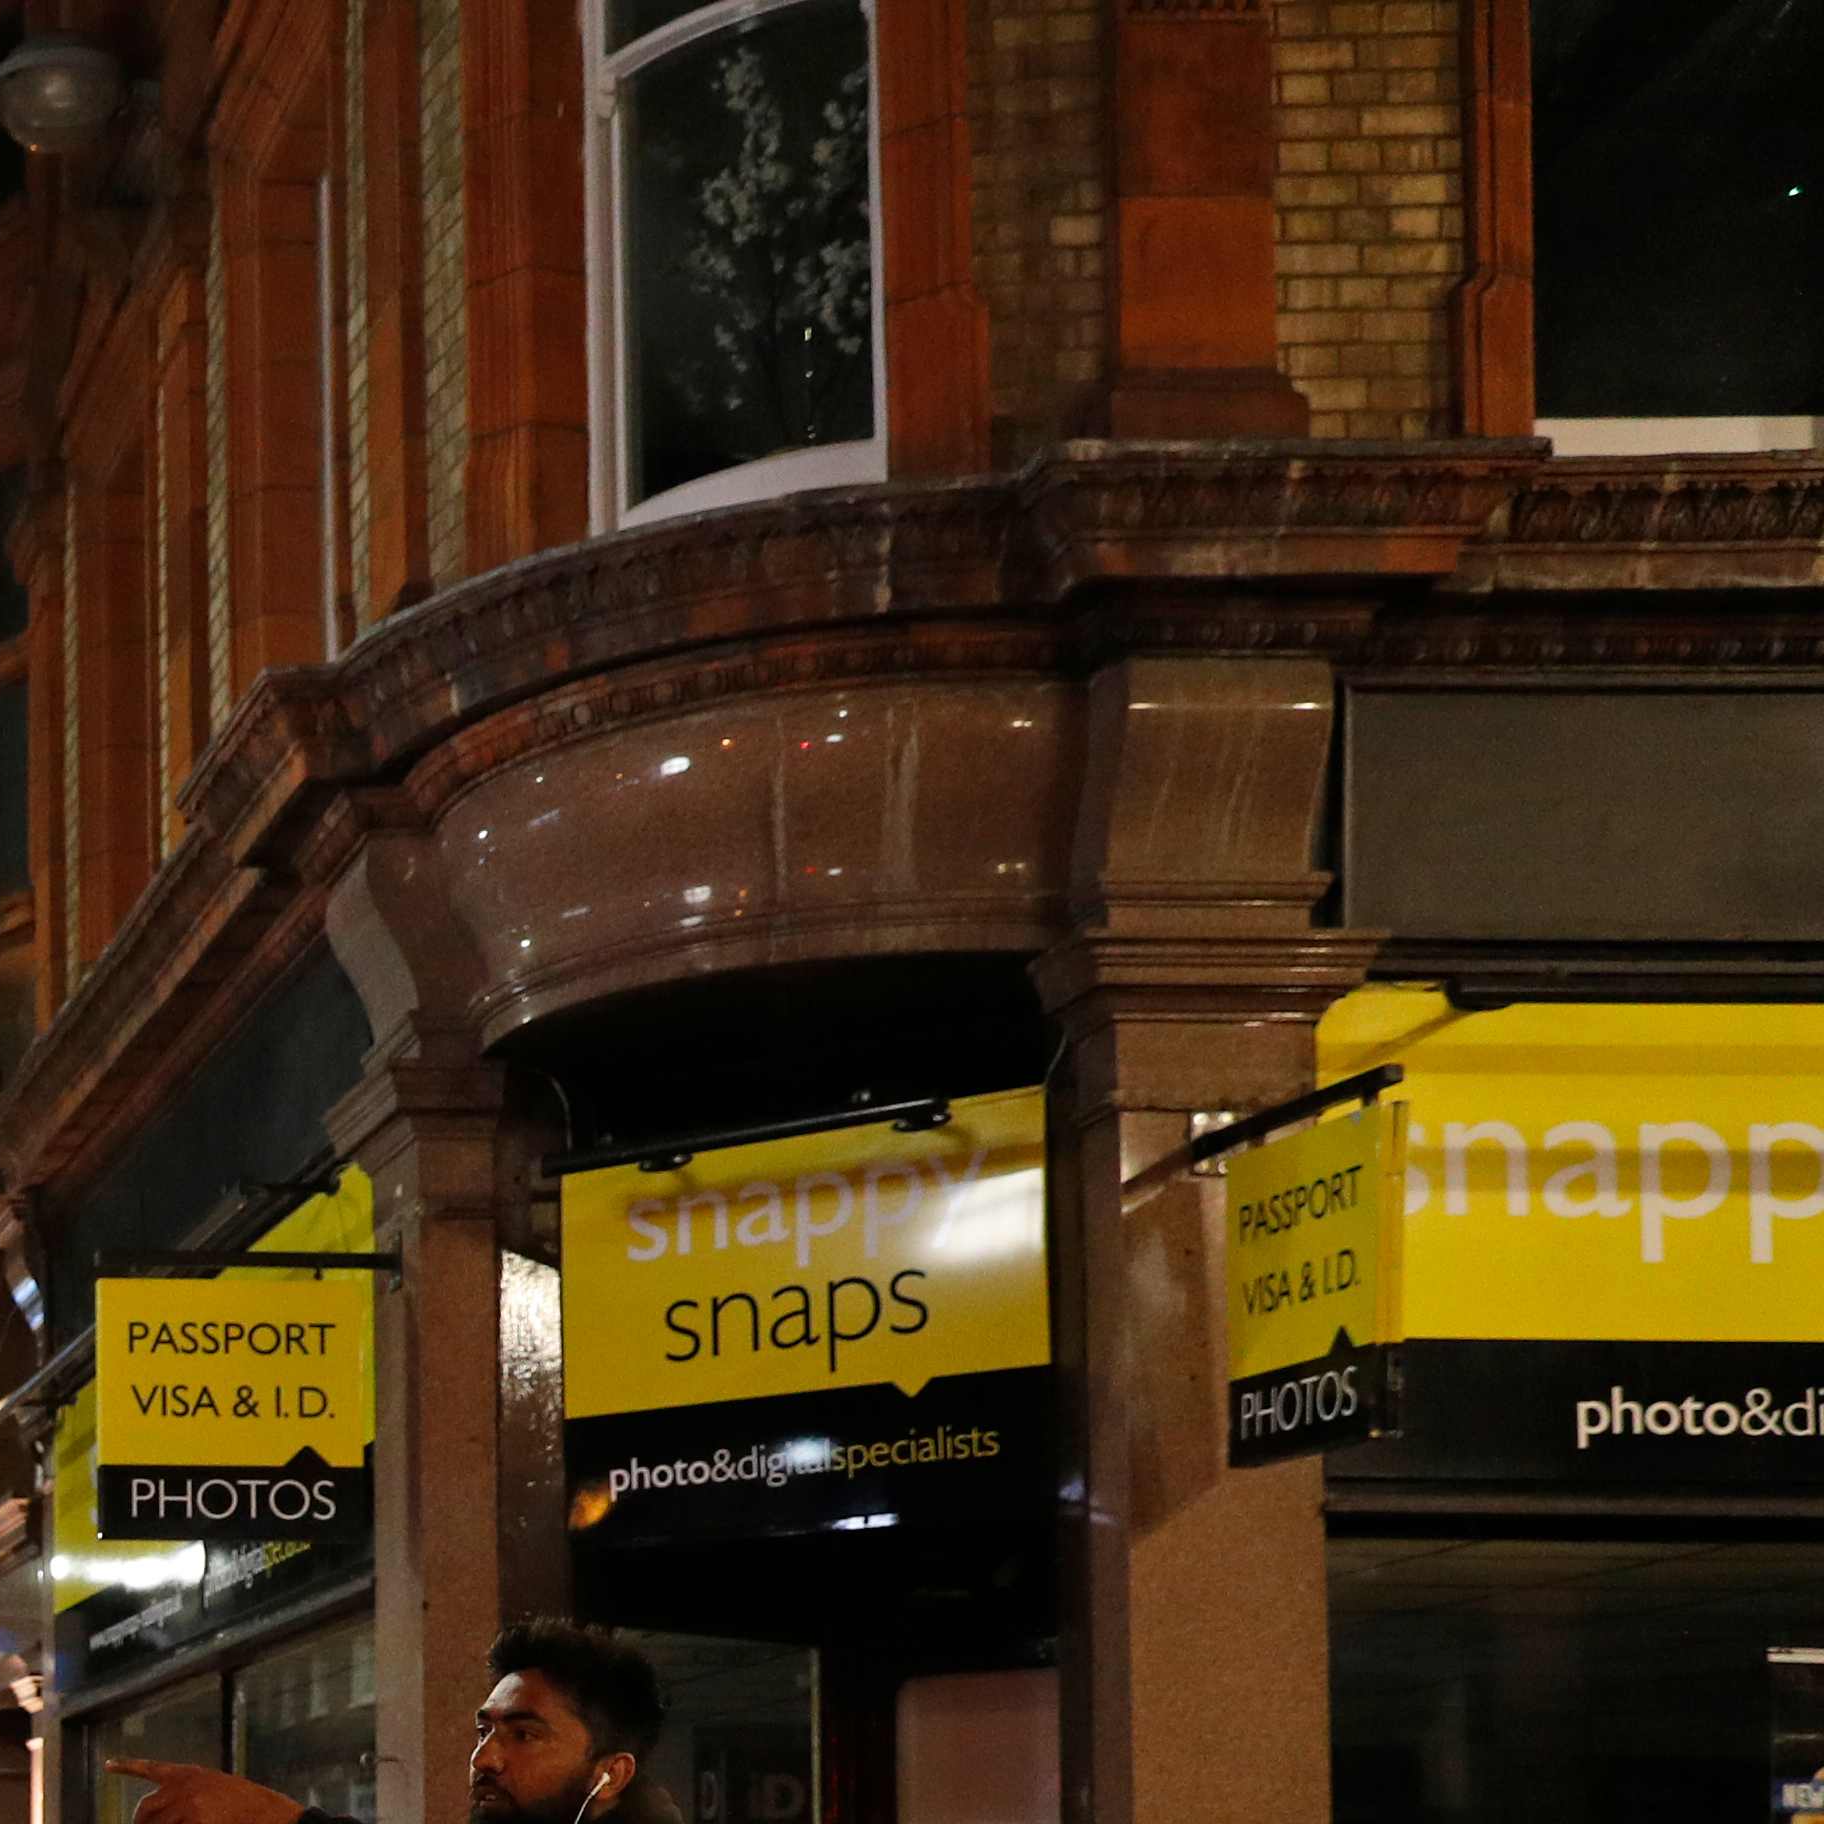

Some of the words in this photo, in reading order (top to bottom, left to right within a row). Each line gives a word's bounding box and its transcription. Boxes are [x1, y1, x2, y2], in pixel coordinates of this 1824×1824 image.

[626, 1146, 988, 1270] snappy
[1238, 1164, 1362, 1246] PASSPORT
[665, 1269, 929, 1373] snaps
[1242, 1268, 1292, 1317] VISA
[1299, 1260, 1319, 1302] &
[128, 1321, 336, 1356] PASSPORT
[132, 1384, 219, 1418] VISA
[232, 1384, 261, 1418] &
[1240, 1365, 1358, 1440] PHOTOS
[131, 1478, 336, 1521] PHOTOS
